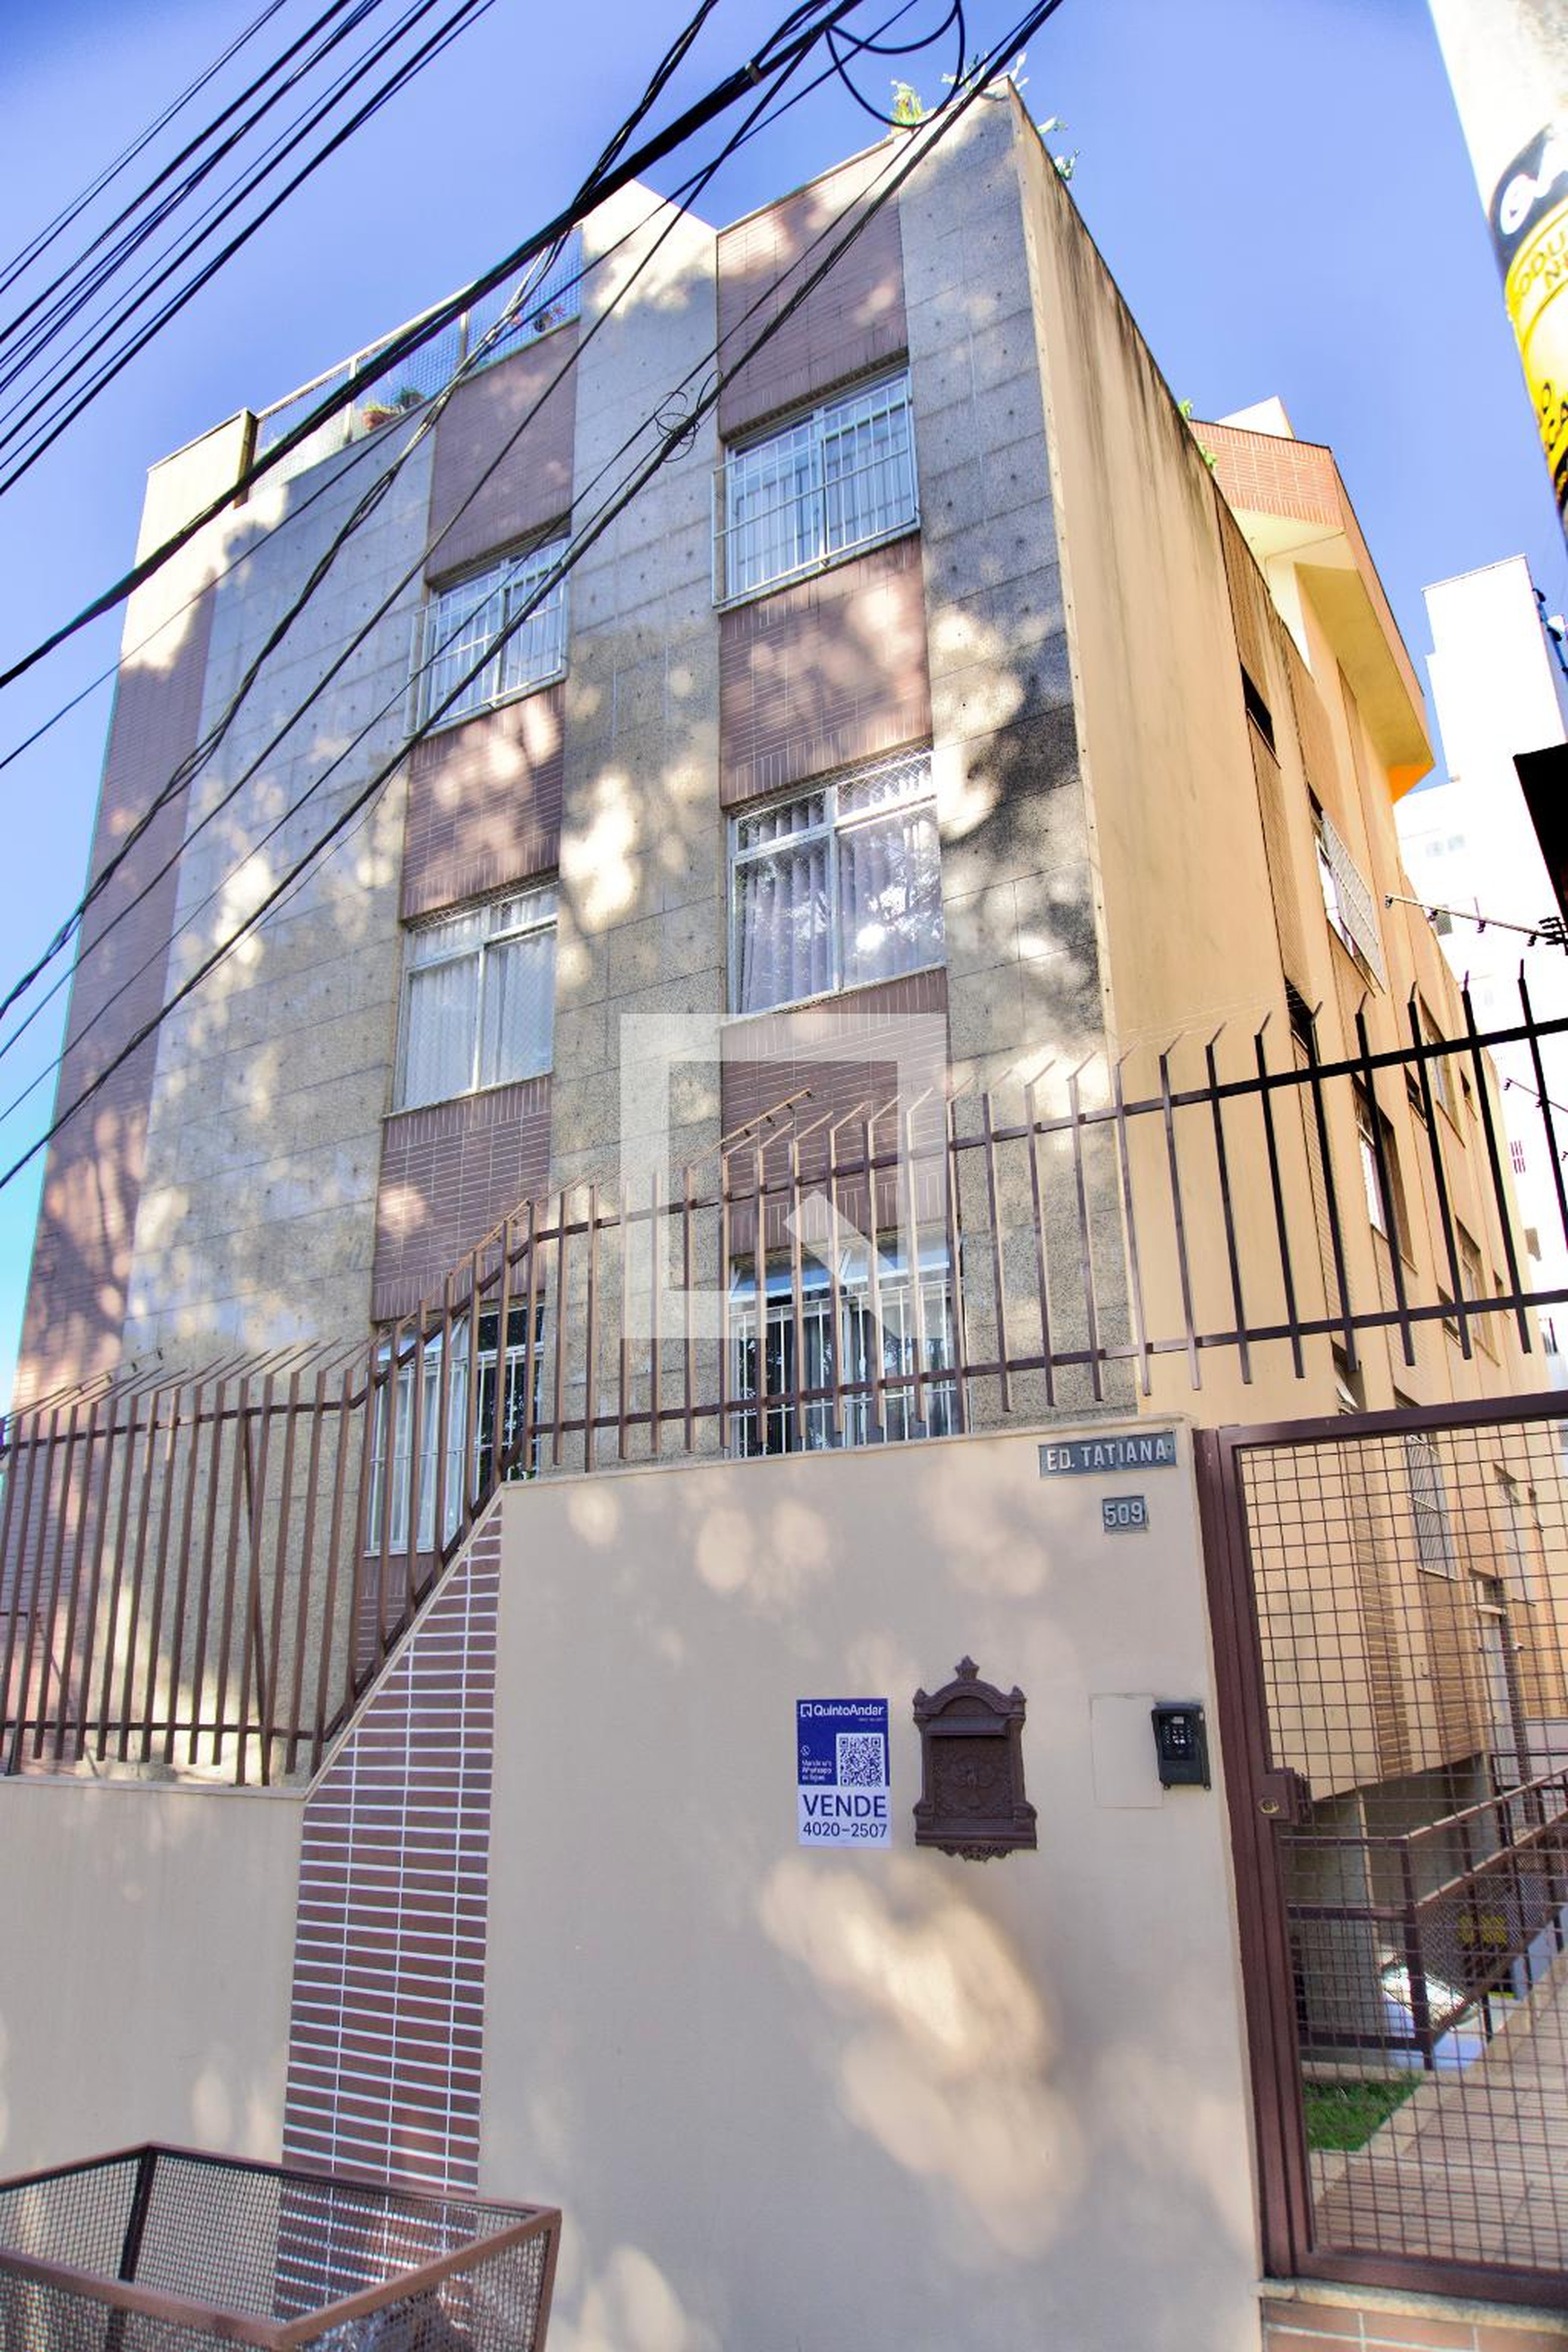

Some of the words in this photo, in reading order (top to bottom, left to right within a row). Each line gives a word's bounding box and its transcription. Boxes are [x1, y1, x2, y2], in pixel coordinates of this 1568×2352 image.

[1047, 1449, 1075, 1470] ED.
[1081, 1439, 1167, 1467] TATIANA
[1104, 1502, 1143, 1526] 509
[814, 1704, 884, 1716] QuintoAndar
[803, 1794, 887, 1817] VENDE
[803, 1822, 887, 1838] 4020-2507
